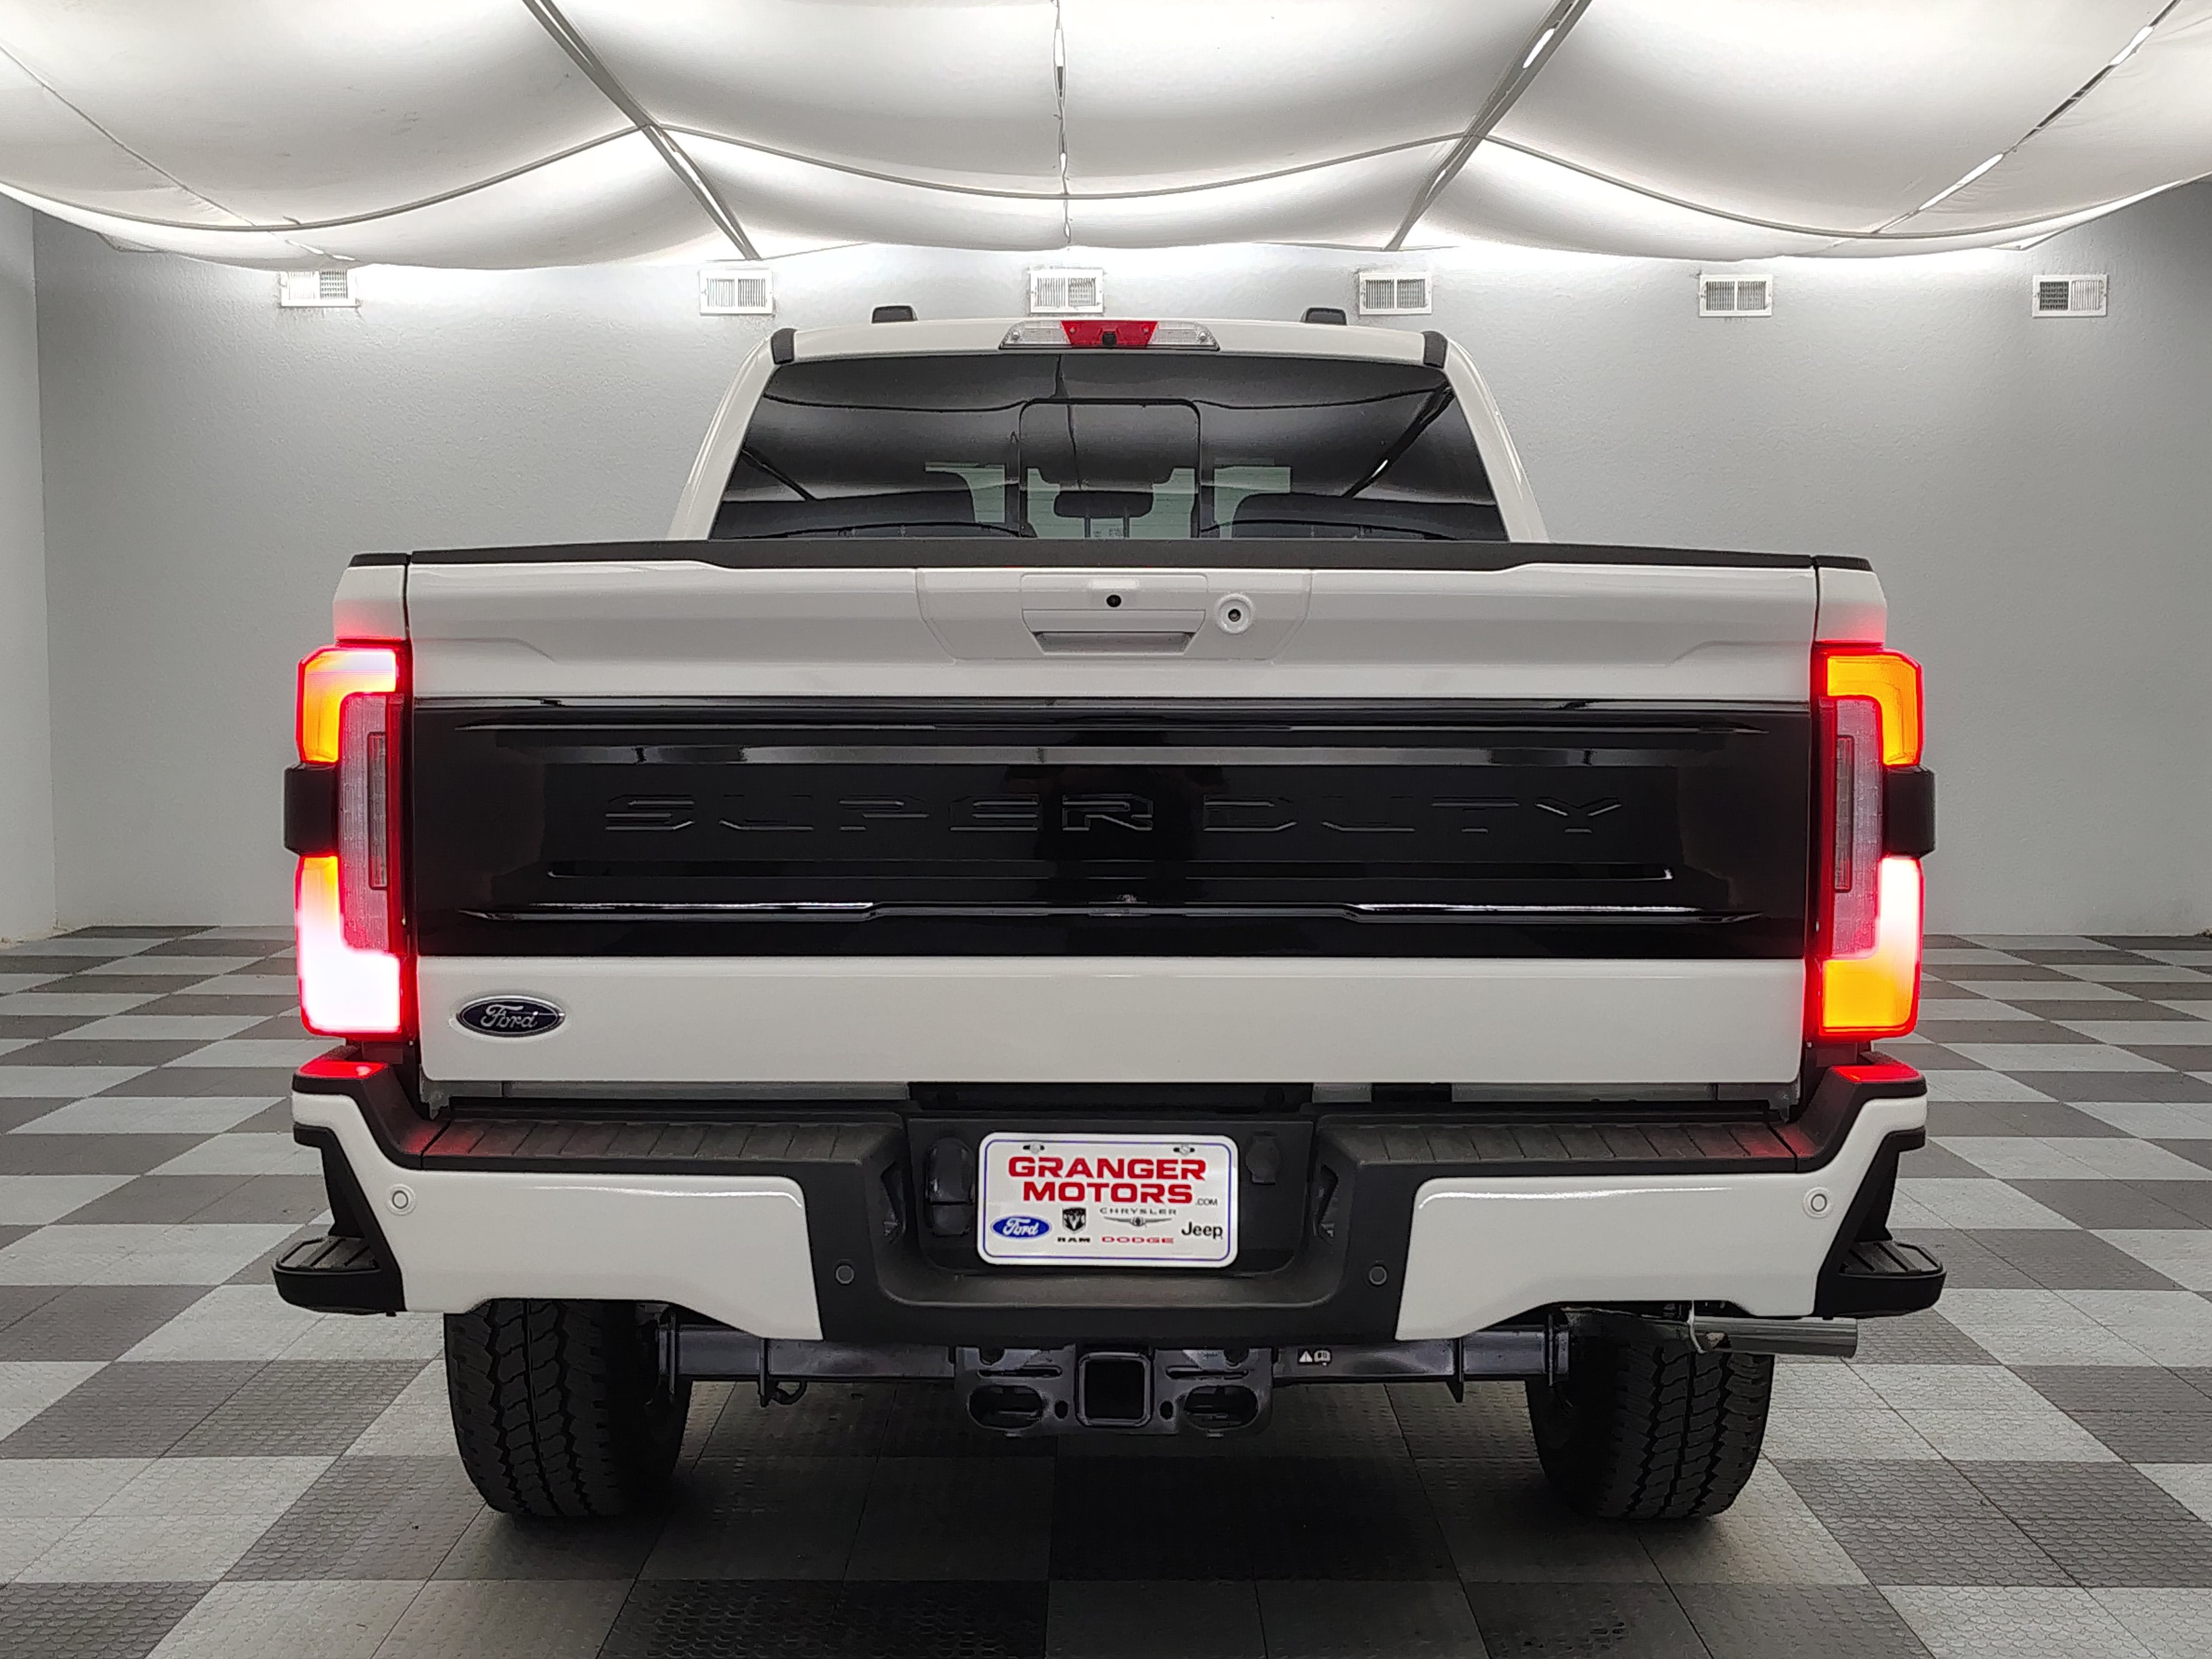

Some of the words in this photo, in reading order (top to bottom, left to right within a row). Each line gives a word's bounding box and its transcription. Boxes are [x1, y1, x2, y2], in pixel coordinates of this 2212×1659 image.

[605, 793, 1153, 831] SUPER
[1203, 793, 1622, 833] DUTY
[480, 1003, 537, 1028] Ford
[1008, 1156, 1206, 1181] GRANGER
[1023, 1181, 1193, 1204] MOTORS
[1100, 1207, 1177, 1215] CHRYSLER
[1002, 1218, 1040, 1236] Ford
[1181, 1221, 1223, 1239] Jeep
